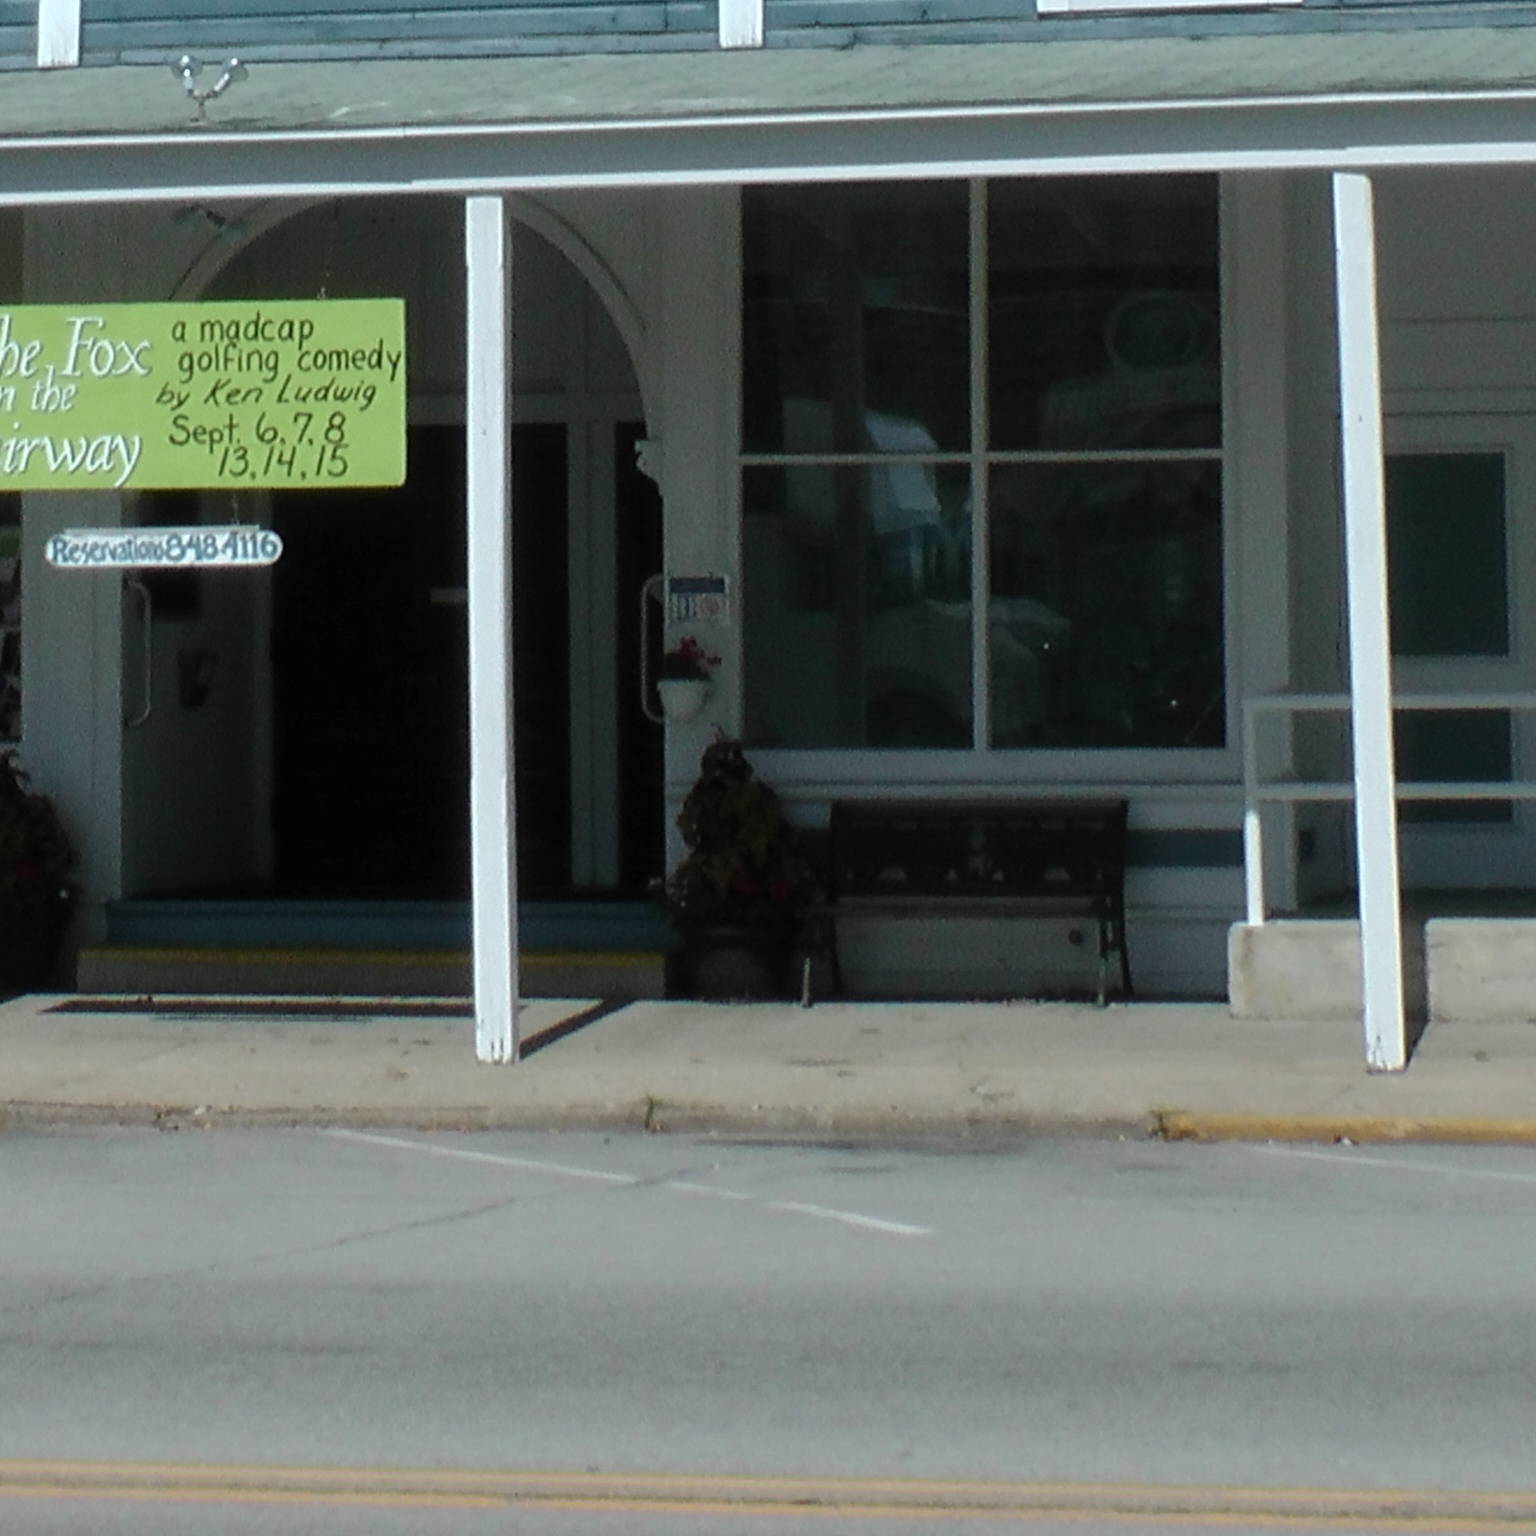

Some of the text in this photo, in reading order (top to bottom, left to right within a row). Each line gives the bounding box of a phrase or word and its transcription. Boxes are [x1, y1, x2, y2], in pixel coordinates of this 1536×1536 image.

[61, 316, 152, 378] Fox
[172, 310, 314, 351] a madcap
[178, 338, 402, 384] golfing comedy
[31, 365, 77, 412] the
[155, 374, 376, 412] by Ken Ludwig
[168, 413, 239, 454] Sept.
[53, 533, 164, 564] Reservations
